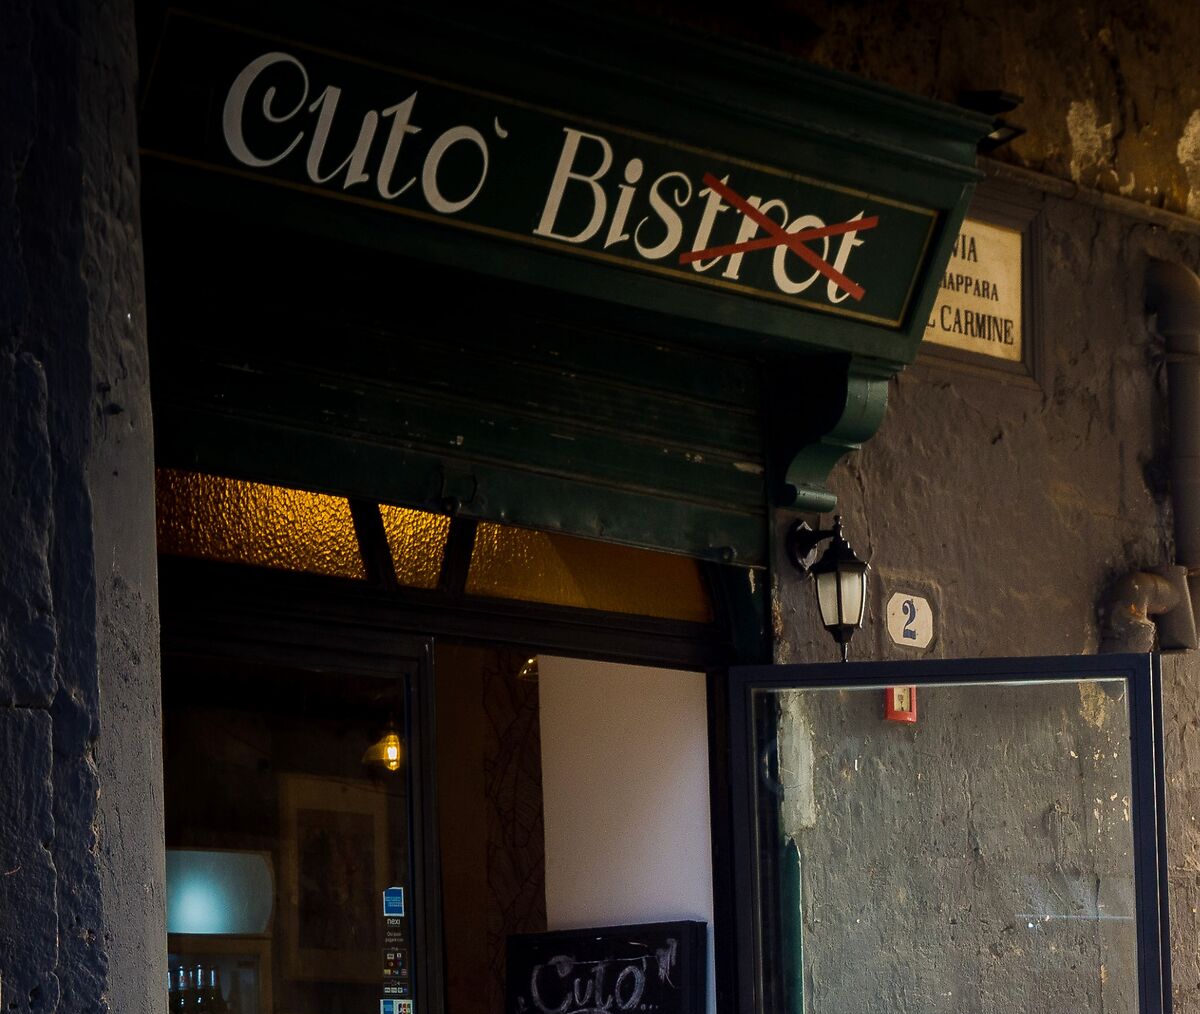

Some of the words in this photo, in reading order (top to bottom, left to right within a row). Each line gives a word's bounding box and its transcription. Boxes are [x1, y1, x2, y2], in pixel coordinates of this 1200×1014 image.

[532, 127, 864, 303] Bistrot
[940, 305, 1014, 345] CARMINE
[902, 600, 917, 640] 2
